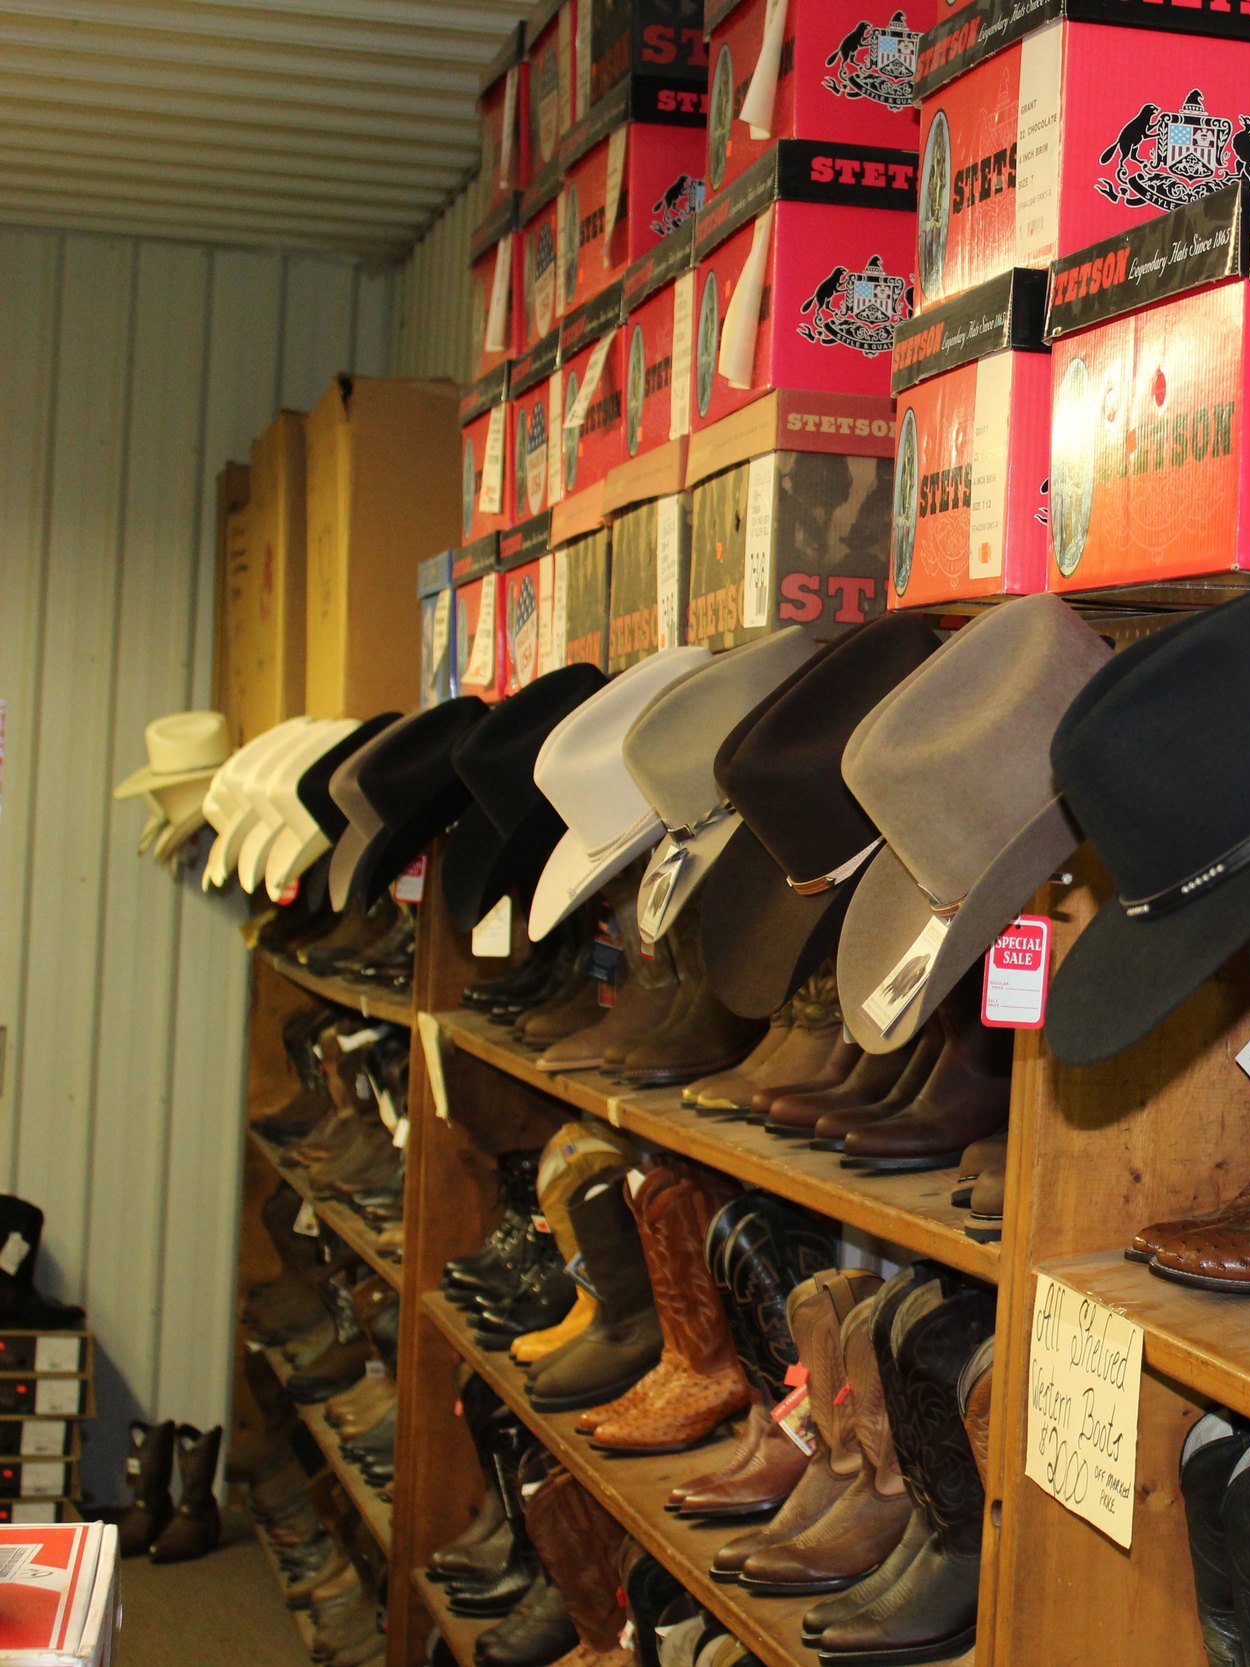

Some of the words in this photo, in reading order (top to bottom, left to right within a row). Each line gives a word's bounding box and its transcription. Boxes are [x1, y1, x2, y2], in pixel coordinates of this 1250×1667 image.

[915, 15, 982, 83] STETSON
[861, 87, 885, 102] STYLE
[1020, 99, 1037, 116] GRANT
[1027, 113, 1058, 136] CHOCOLATE
[1035, 142, 1049, 158] BRIM
[810, 155, 918, 190] STET
[1144, 192, 1176, 211] STYLE
[1128, 248, 1168, 286] Legendary
[1168, 241, 1189, 266] Hats
[1189, 232, 1212, 256] Since
[1213, 227, 1232, 251] 1865
[836, 333, 860, 349] STYLE
[995, 936, 1042, 952] SPECIAL
[1002, 950, 1033, 965] SALE
[1036, 1282, 1066, 1352] All
[1070, 1298, 1136, 1392] Shelved
[1032, 1358, 1072, 1430] Western
[1077, 1386, 1124, 1463] Boots
[1094, 1465, 1106, 1482] OFF
